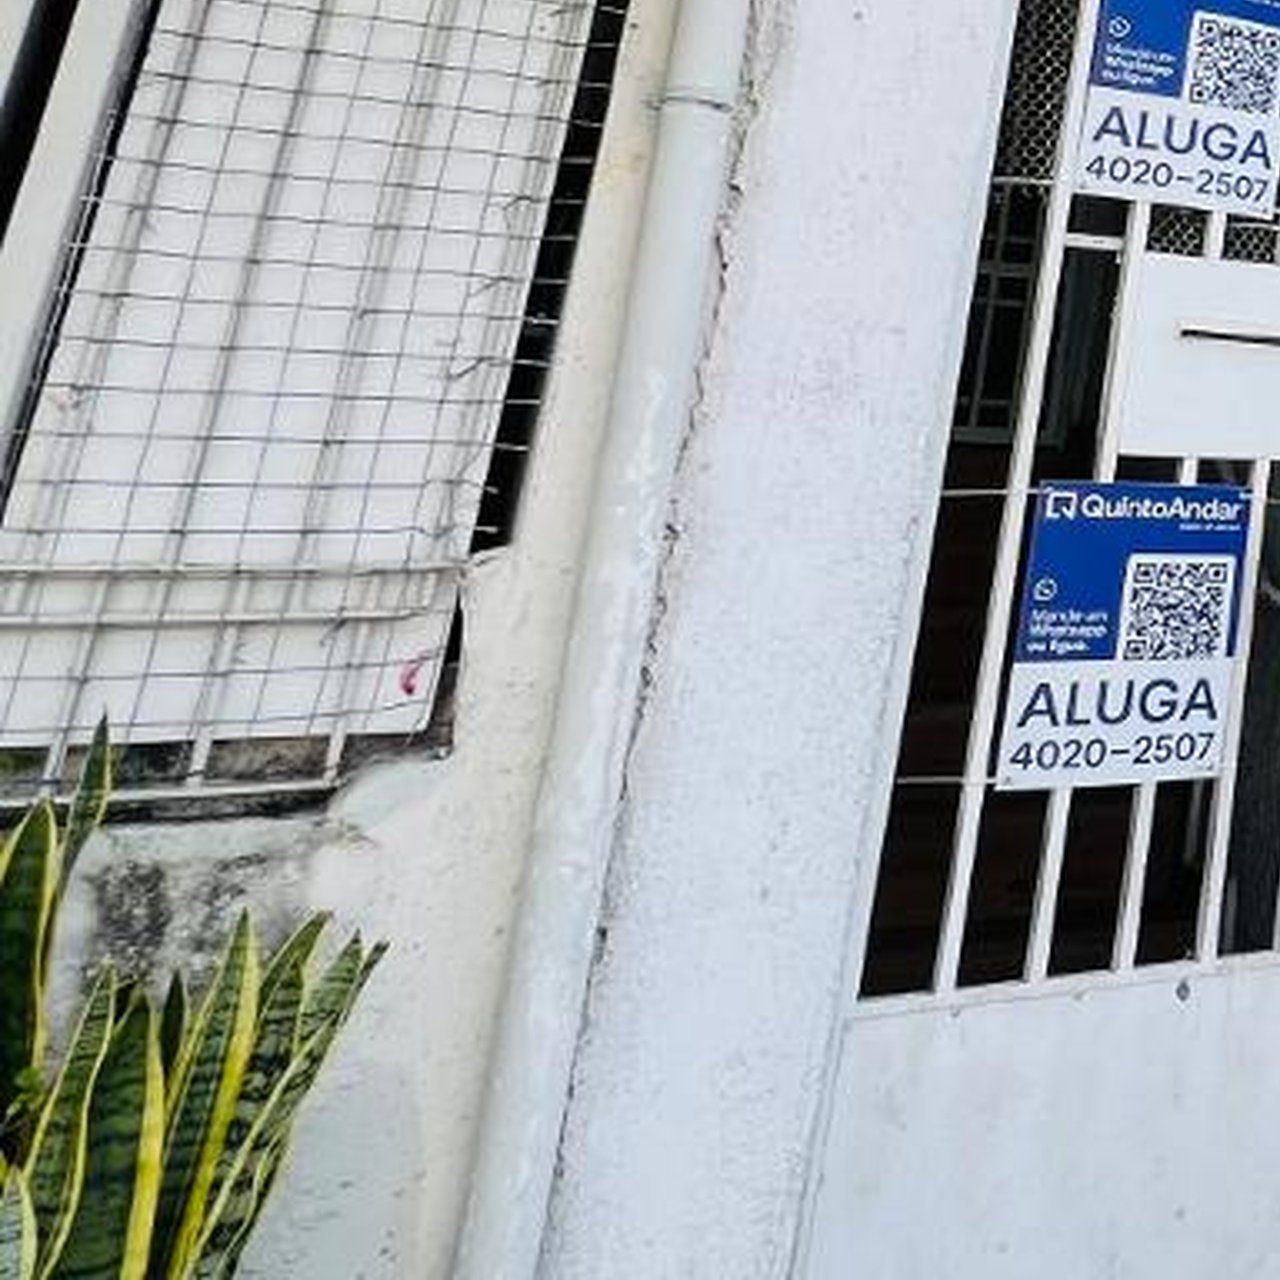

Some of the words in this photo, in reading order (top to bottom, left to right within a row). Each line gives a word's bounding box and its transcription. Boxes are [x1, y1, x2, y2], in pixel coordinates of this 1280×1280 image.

[1093, 106, 1272, 170] ALUGA
[1086, 155, 1269, 204] 4020-2507
[1081, 494, 1241, 520] QuintoAndar
[1017, 678, 1218, 728] ALUGA
[1010, 732, 1215, 771] 4020-2507
